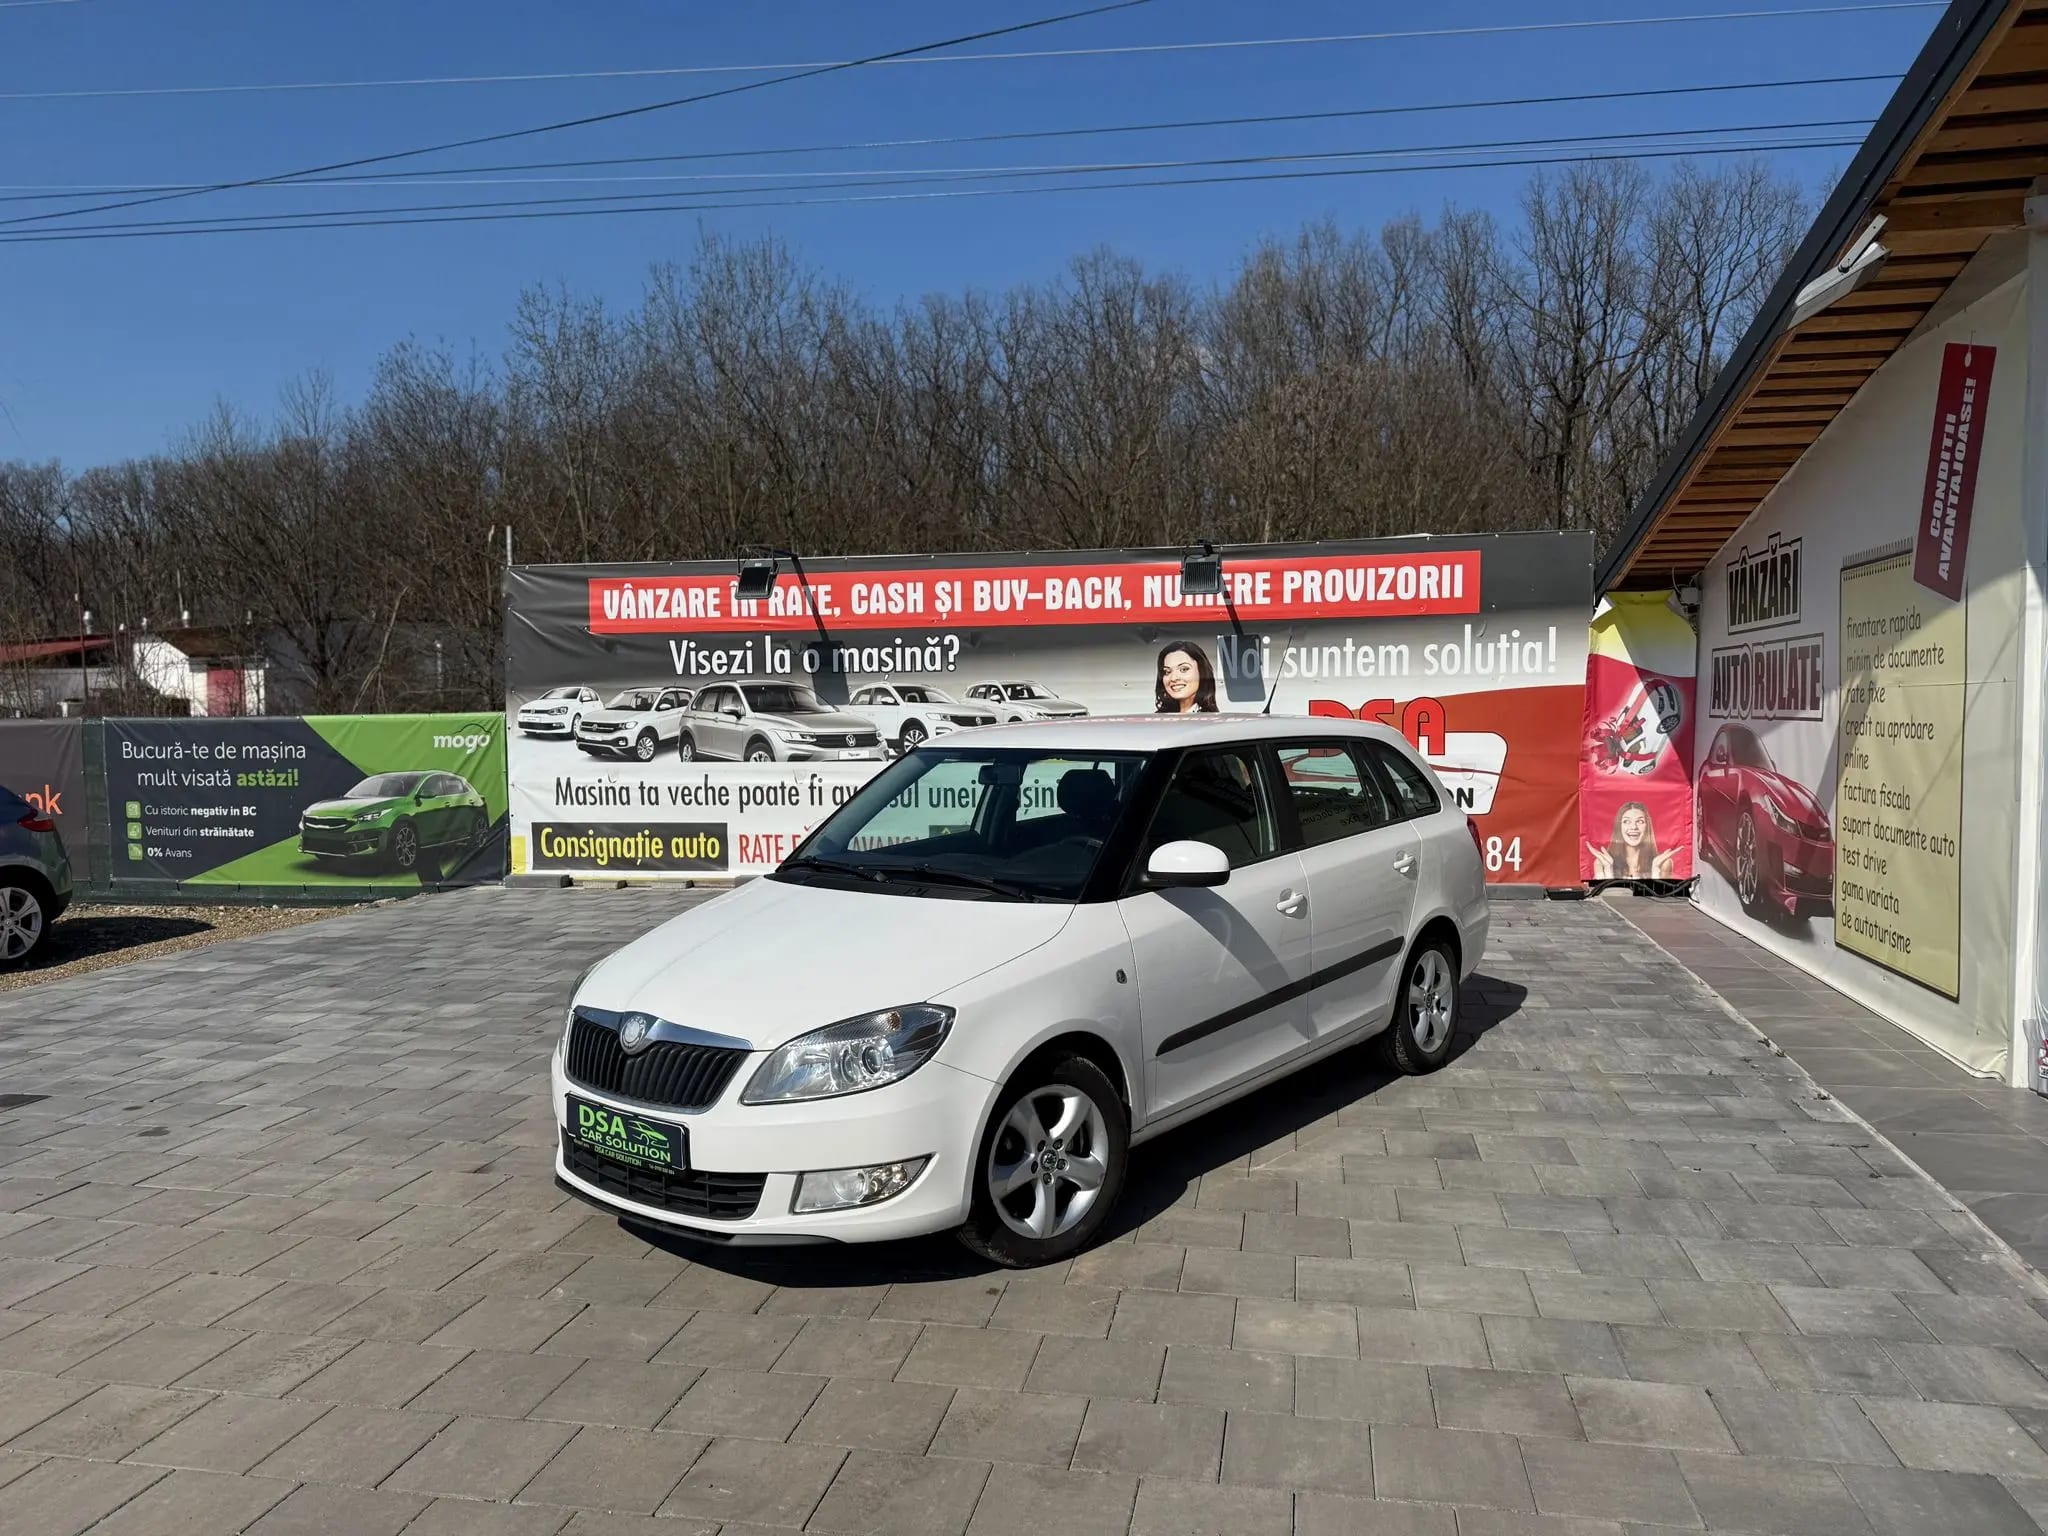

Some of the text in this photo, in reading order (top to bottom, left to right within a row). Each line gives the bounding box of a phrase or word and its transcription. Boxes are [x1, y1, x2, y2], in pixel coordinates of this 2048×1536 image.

[1938, 377, 1977, 581] AVANTAJOASE!
[603, 583, 721, 619] VÂNZARE
[769, 584, 841, 617] RATE,
[851, 581, 924, 615] CASH
[934, 580, 962, 620] ȘI
[974, 575, 1132, 612] BUY-BACK,
[1283, 564, 1463, 604] PROVIZORII
[1728, 542, 1799, 626] VÂNZĂRI
[1846, 605, 1921, 641] finantare rapida
[668, 634, 960, 681] Visezi la o mașină?
[1216, 634, 1272, 680] Noi
[1284, 637, 1410, 679] suntem
[1846, 642, 1945, 672] minim de documente
[1846, 680, 1886, 704] rate fixe
[433, 734, 491, 754] mogo
[1845, 714, 1935, 745] credit cu aprobare
[122, 741, 306, 763] Bucură-te de mașina
[1844, 747, 1869, 770] online
[137, 768, 299, 787] mult visată astăzi!
[638, 780, 660, 806] ta
[667, 774, 730, 806] veche
[738, 779, 800, 813] poate
[808, 773, 824, 806] fi
[928, 780, 977, 808] unei
[1843, 777, 1911, 811] factura fiscala
[145, 805, 158, 815] Cu
[160, 805, 189, 815] istoric
[191, 806, 228, 817] negativ
[242, 806, 257, 816] BC
[145, 826, 255, 837] Venituri din străinătate
[541, 827, 720, 865] Consignație auto
[1842, 815, 1955, 858] suport documente auto
[147, 847, 192, 858] 0% Avans
[739, 834, 784, 864] RATE
[1481, 836, 1523, 872] 84
[1842, 844, 1887, 875] test drive
[1841, 880, 1900, 914] gama variata
[1841, 905, 1912, 954] de autoturisme
[579, 1104, 628, 1139] DSA
[580, 1127, 603, 1143] CAR
[605, 1135, 671, 1162] SOLUTION
